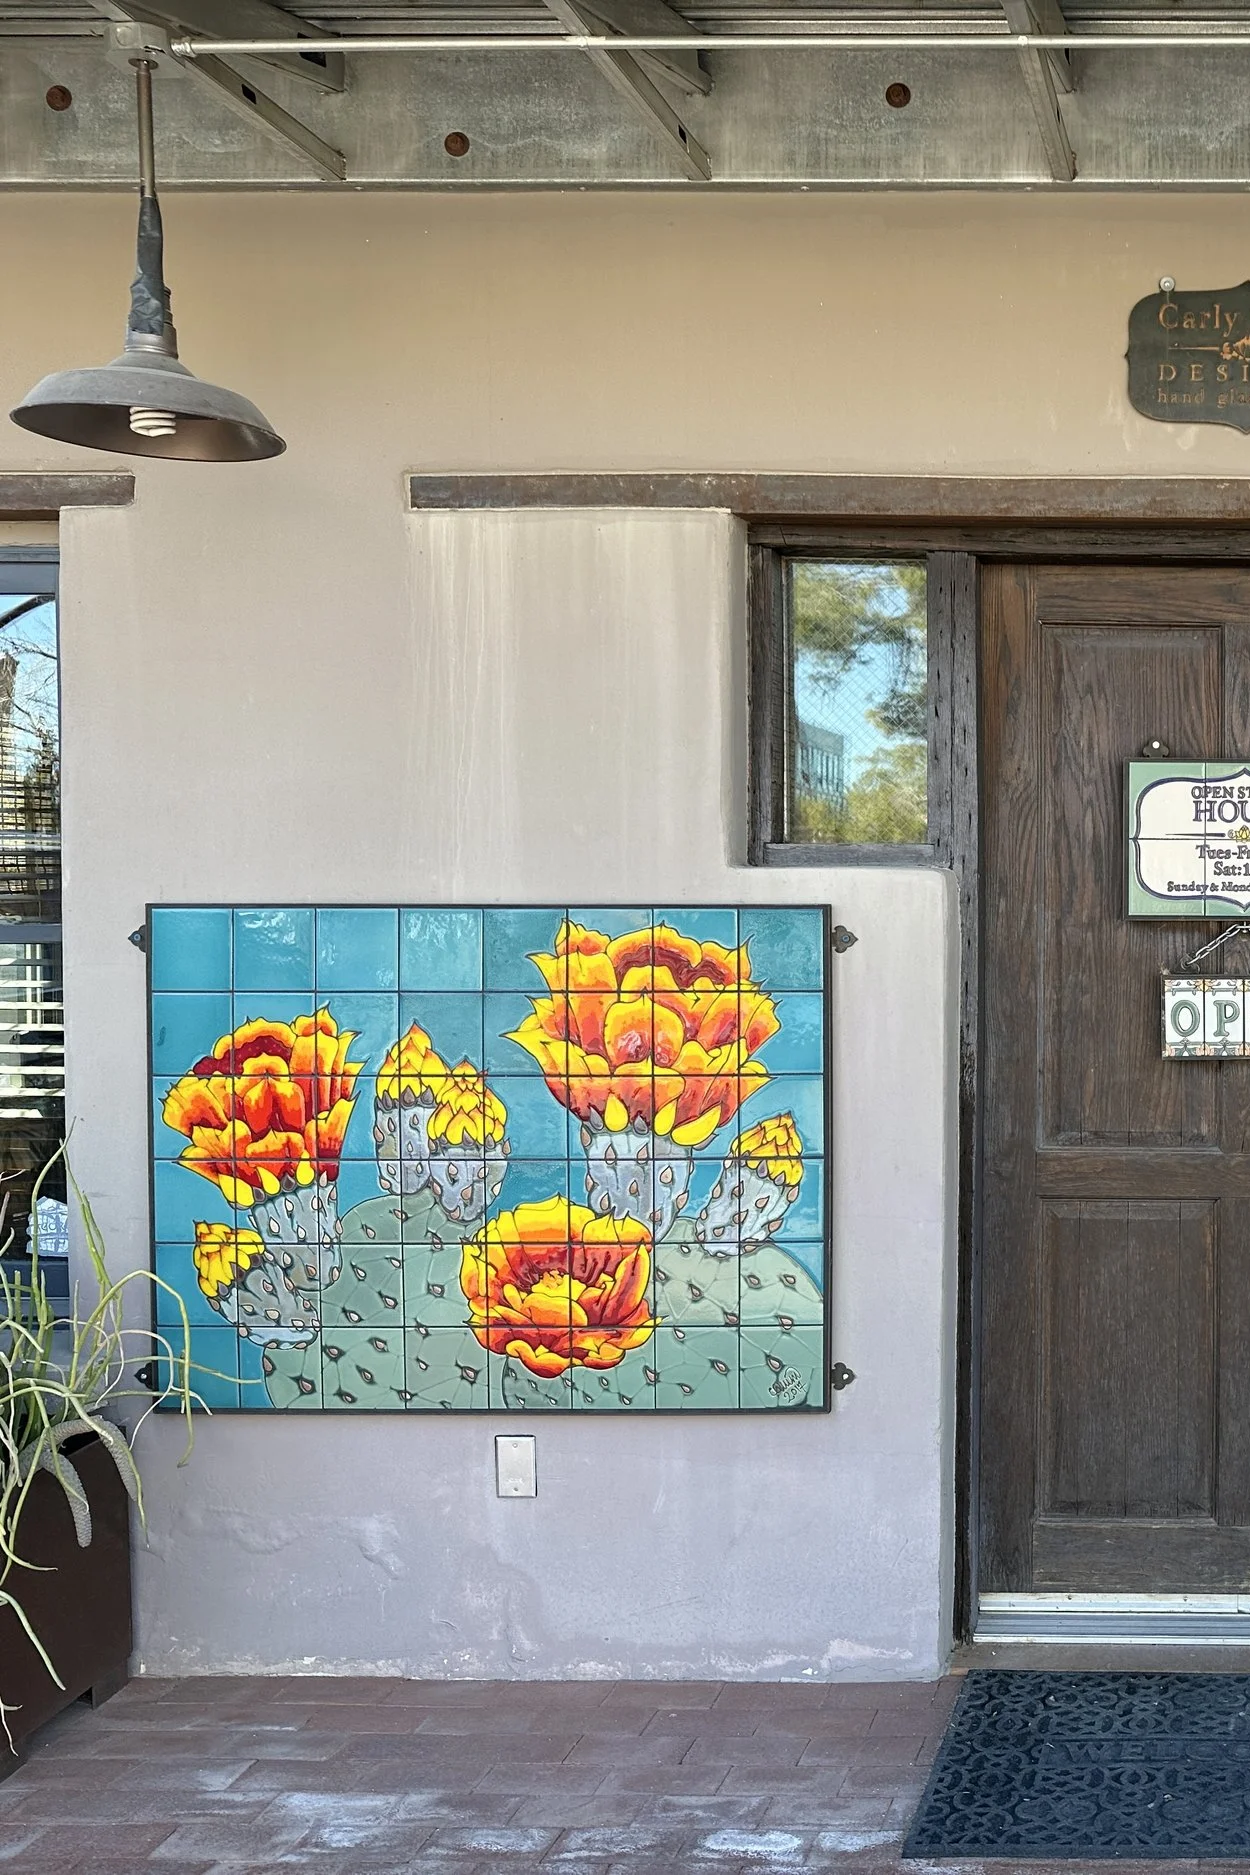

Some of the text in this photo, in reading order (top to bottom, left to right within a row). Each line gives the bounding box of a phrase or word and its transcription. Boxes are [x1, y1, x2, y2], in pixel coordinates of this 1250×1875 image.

[1158, 303, 1239, 337] Carly
[1157, 388, 1205, 404] hand
[1191, 786, 1235, 799] OPEN
[1167, 881, 1209, 895] Sunday
[1210, 882, 1219, 893] &
